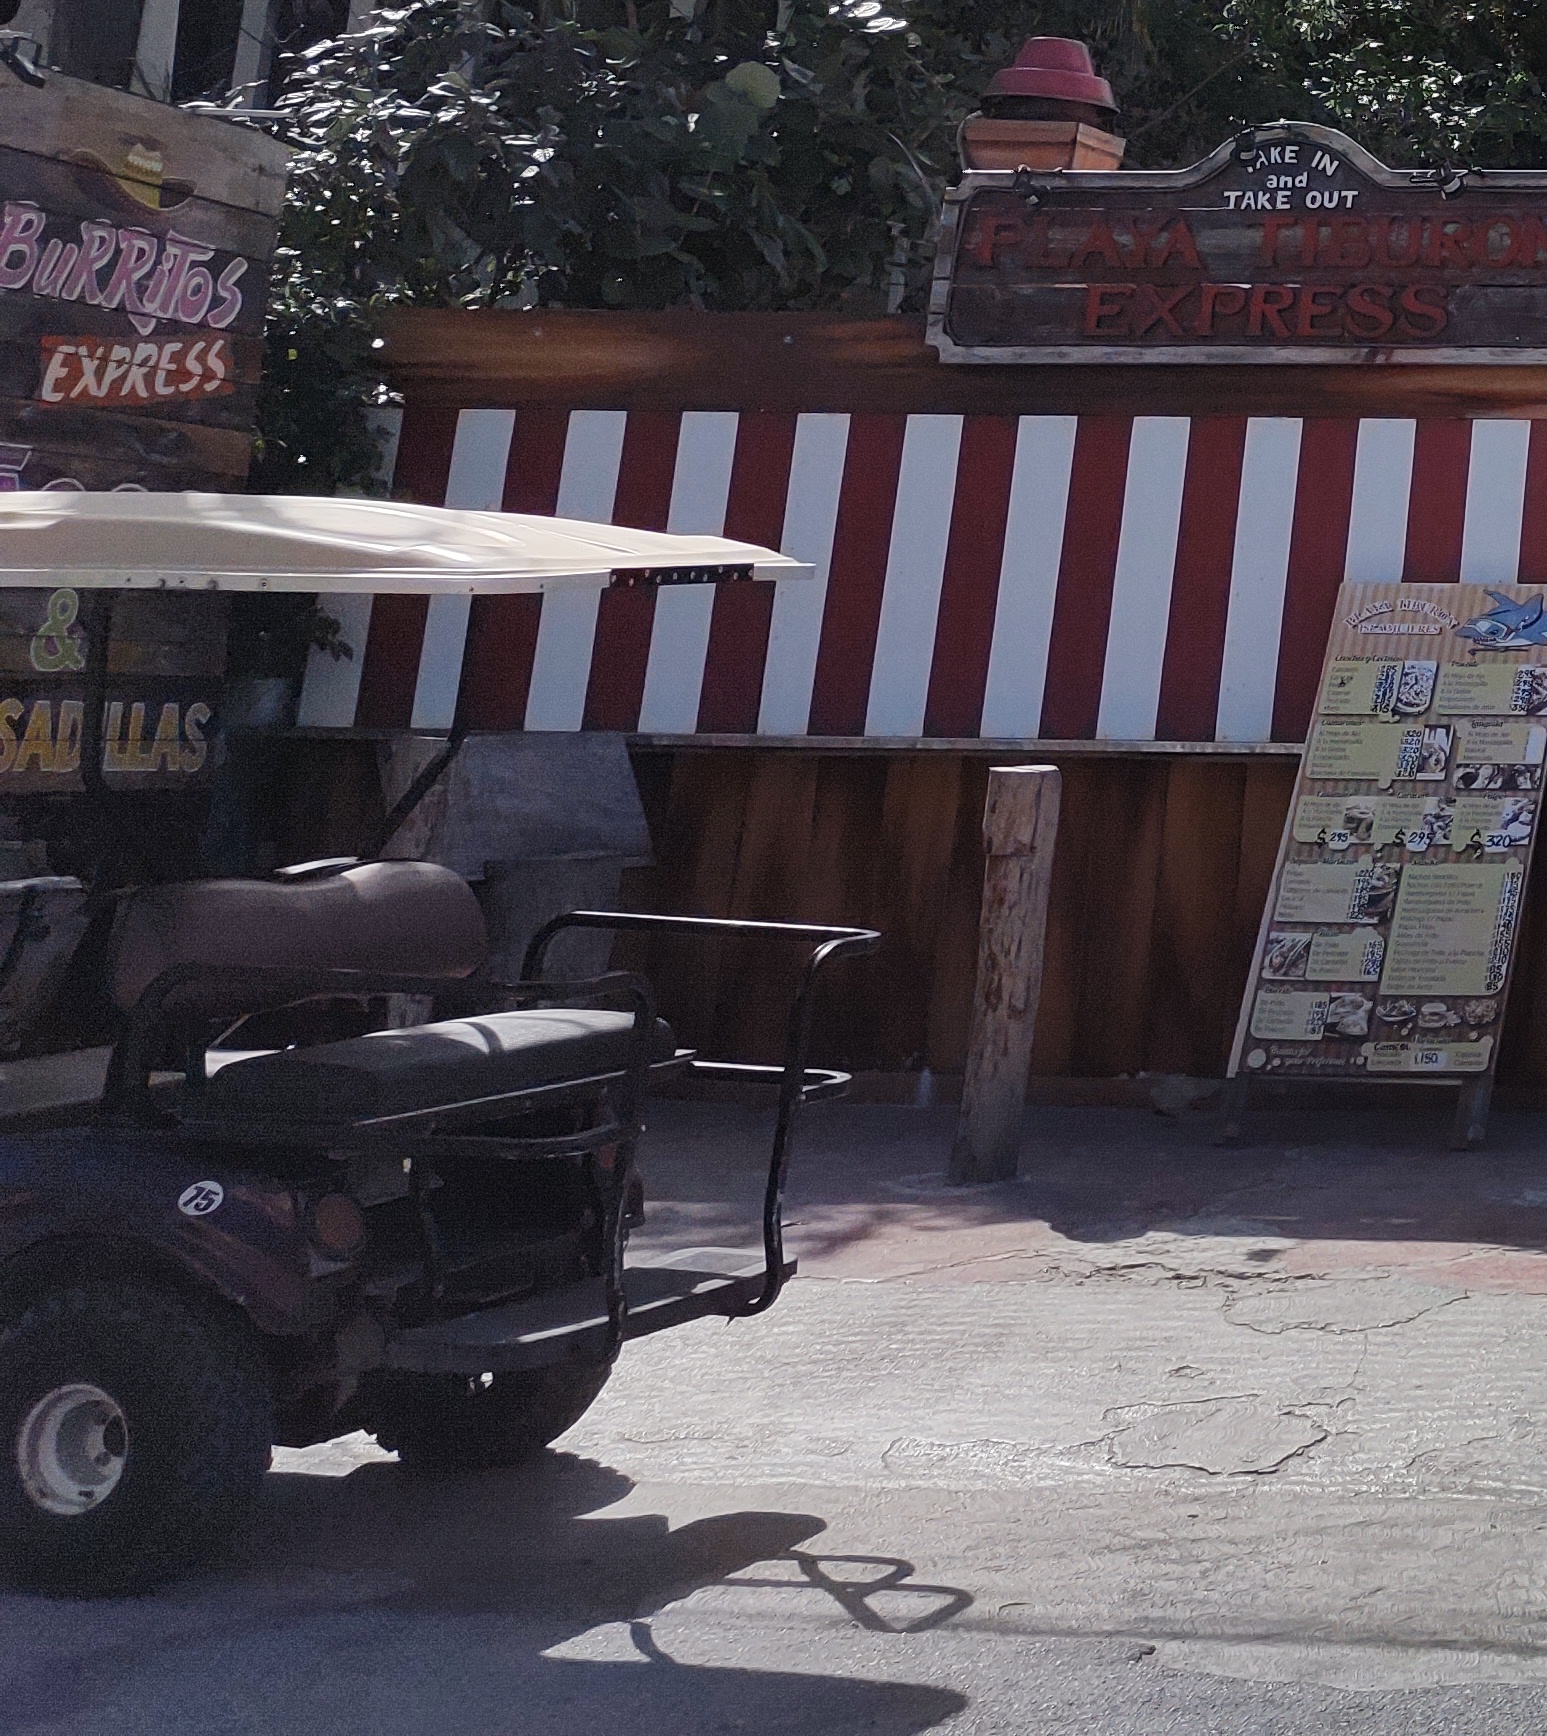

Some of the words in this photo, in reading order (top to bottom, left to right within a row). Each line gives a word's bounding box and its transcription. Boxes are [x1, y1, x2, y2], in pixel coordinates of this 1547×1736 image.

[1247, 145, 1300, 173] AKE
[1311, 150, 1340, 176] IN
[1266, 171, 1309, 188] and
[1223, 190, 1292, 210] TAKE
[1305, 190, 1359, 210] OUT
[975, 214, 1201, 265] PLAYA
[1082, 282, 1449, 339] EXPRESS
[41, 339, 226, 402] EXPRESS
